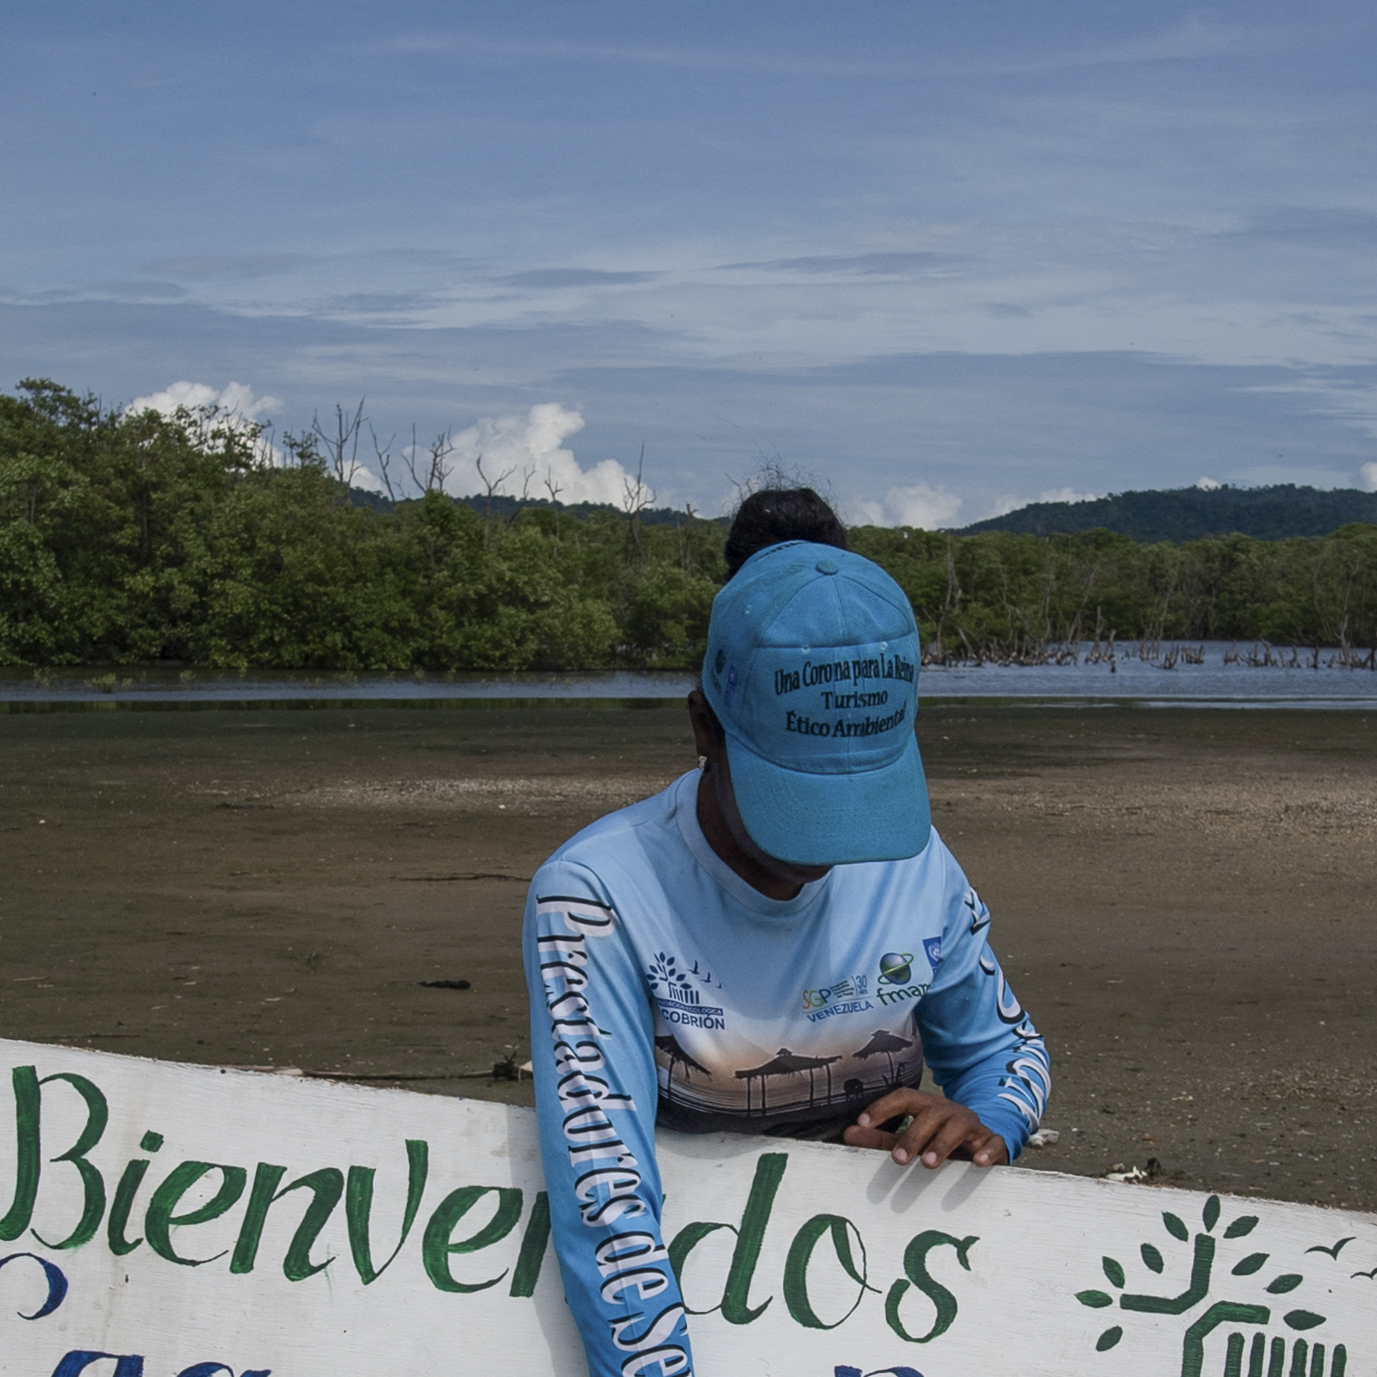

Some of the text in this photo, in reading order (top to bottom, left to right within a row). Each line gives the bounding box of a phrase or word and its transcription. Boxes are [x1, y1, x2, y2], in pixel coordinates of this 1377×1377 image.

[775, 652, 915, 696] Una Corona para La Reina
[821, 690, 889, 710] Turismo
[786, 700, 908, 738] Ético Ambiental
[802, 987, 832, 1010] SGP
[855, 974, 869, 989] 30
[661, 1008, 726, 1031] COBRIÓN
[806, 1000, 874, 1023] VENEZUELA
[536, 894, 649, 1229] Prestadores
[594, 1230, 670, 1305] de
